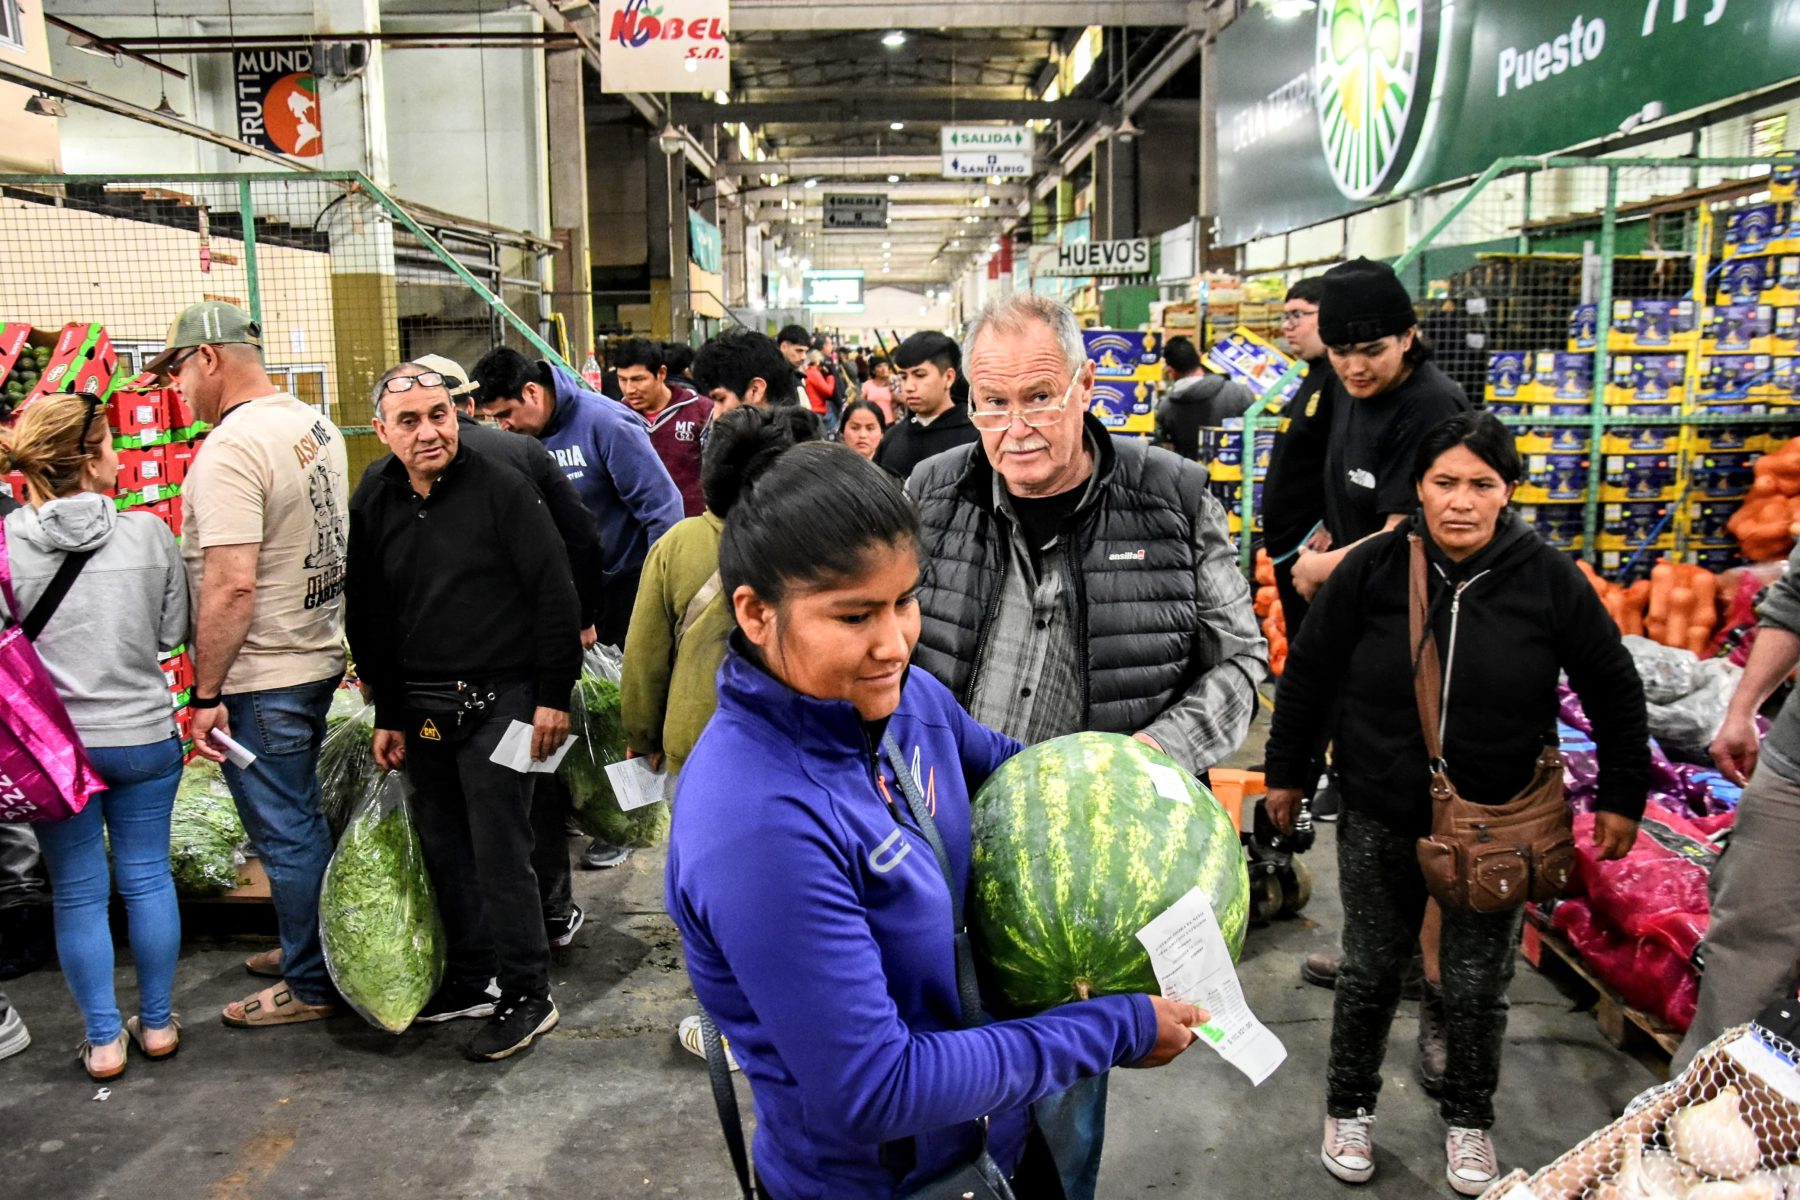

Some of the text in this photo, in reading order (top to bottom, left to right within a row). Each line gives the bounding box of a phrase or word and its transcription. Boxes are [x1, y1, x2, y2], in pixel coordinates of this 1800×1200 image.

[609, 9, 723, 46] NOBEL
[238, 51, 313, 73] MUND
[1497, 15, 1605, 97] Puesto
[238, 73, 265, 150] FRUTI
[961, 133, 1012, 143] SALIDA
[960, 165, 1025, 174] SANITARIO
[1058, 241, 1146, 267] HUEVOS
[292, 431, 318, 470] ASK
[547, 444, 588, 467] RIA
[424, 727, 435, 738] CAT
